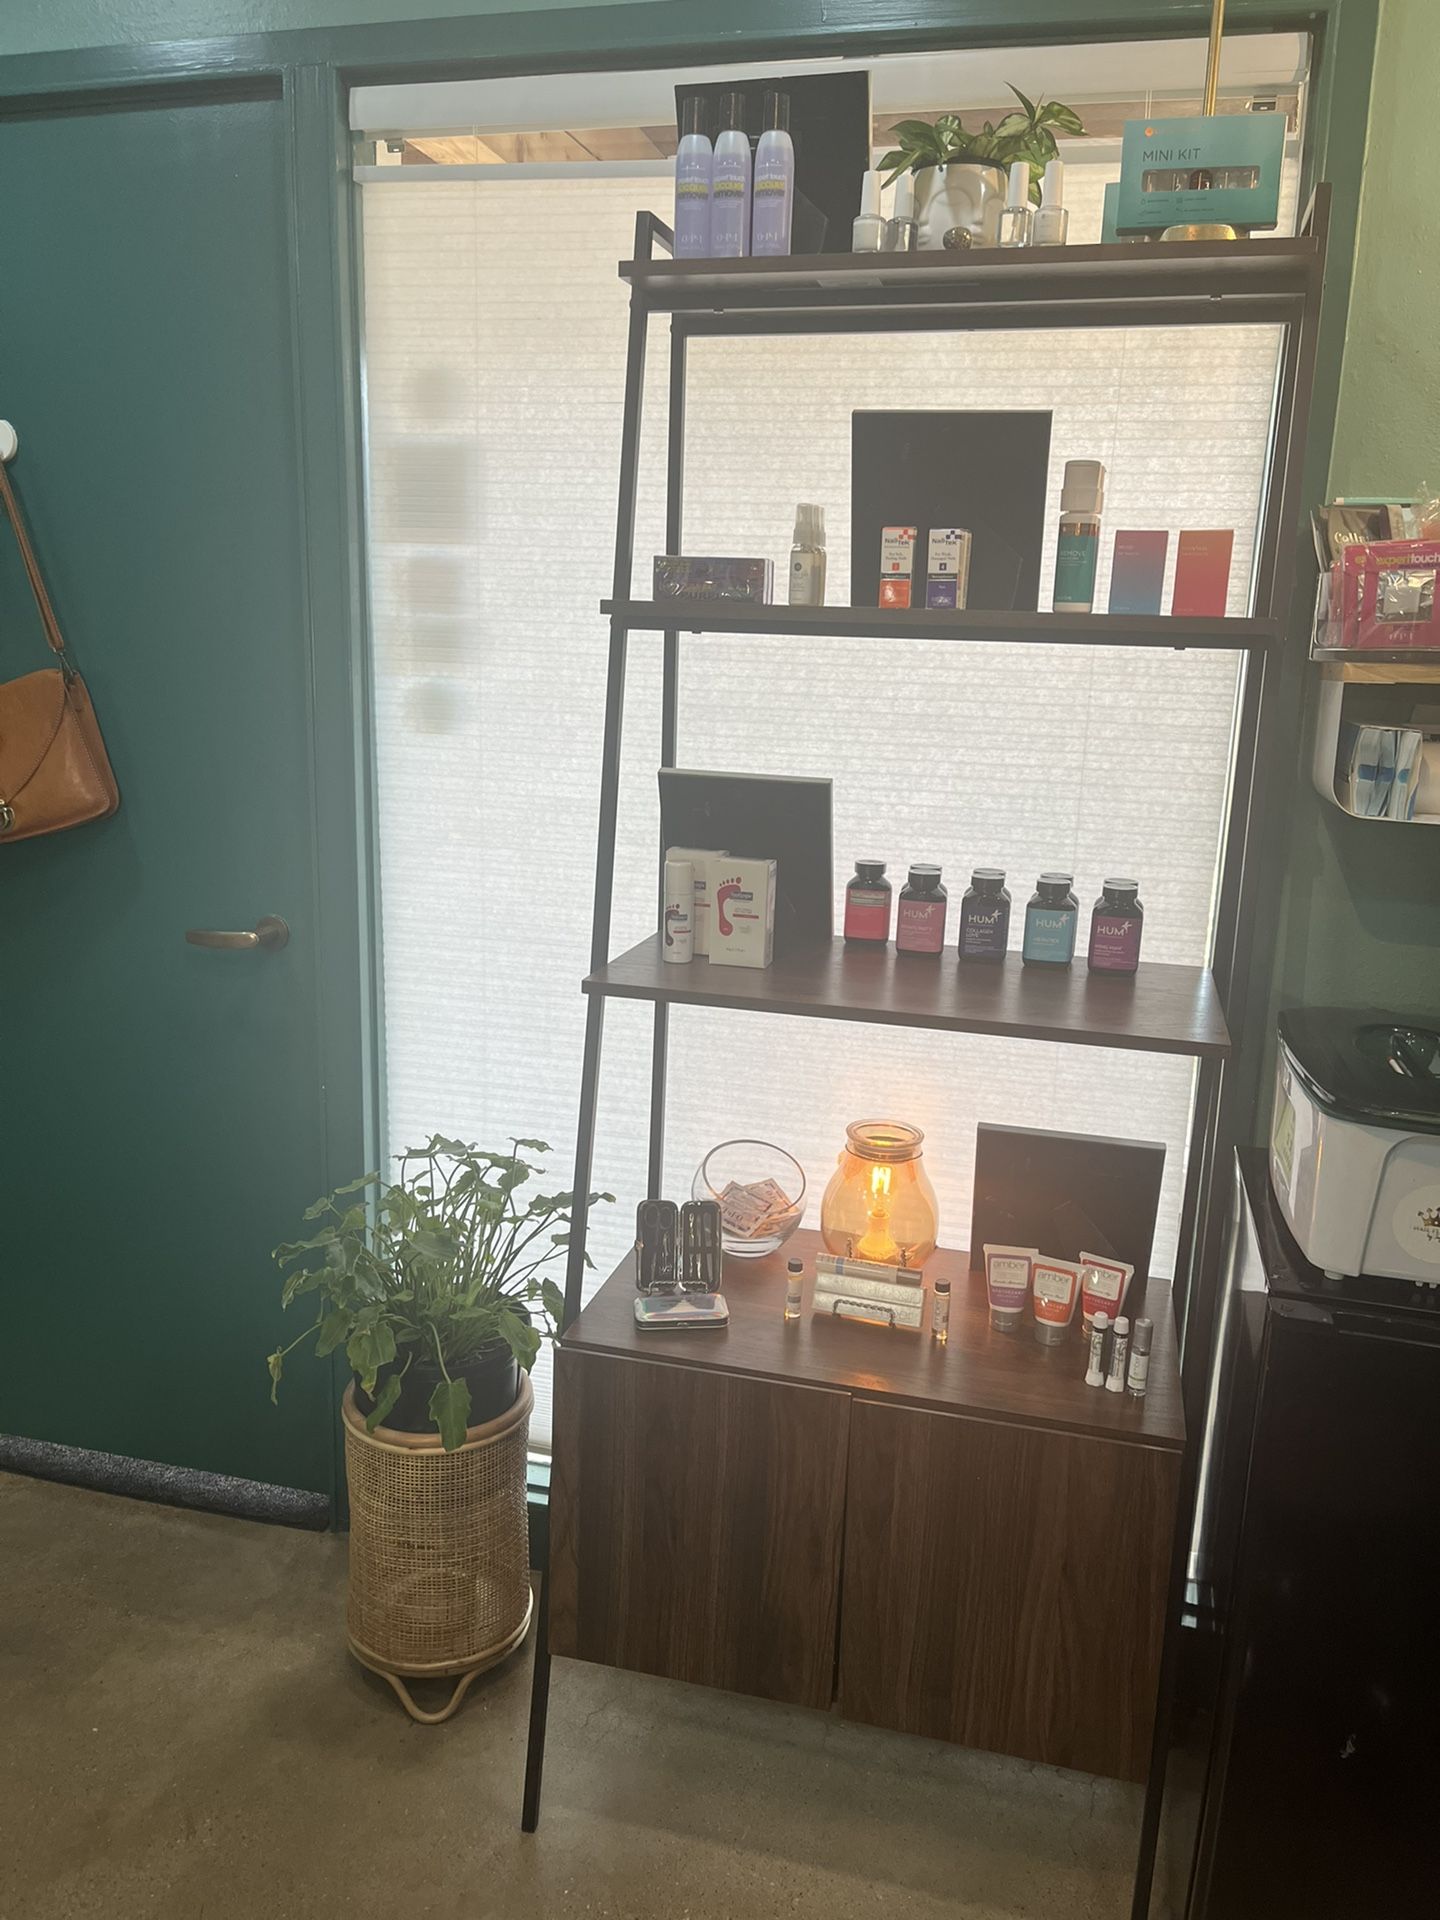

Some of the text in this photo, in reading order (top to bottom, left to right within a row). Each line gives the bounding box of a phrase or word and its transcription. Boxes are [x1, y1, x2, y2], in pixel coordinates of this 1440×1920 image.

[1142, 148, 1201, 161] MINI KIT
[903, 908, 928, 919] HUM
[968, 914, 995, 925] HUM
[1035, 918, 1062, 929] HUM
[1096, 924, 1125, 936] HUM
[993, 1261, 1026, 1269] amber
[1036, 1270, 1069, 1283] amber
[1085, 1266, 1120, 1279] amber
